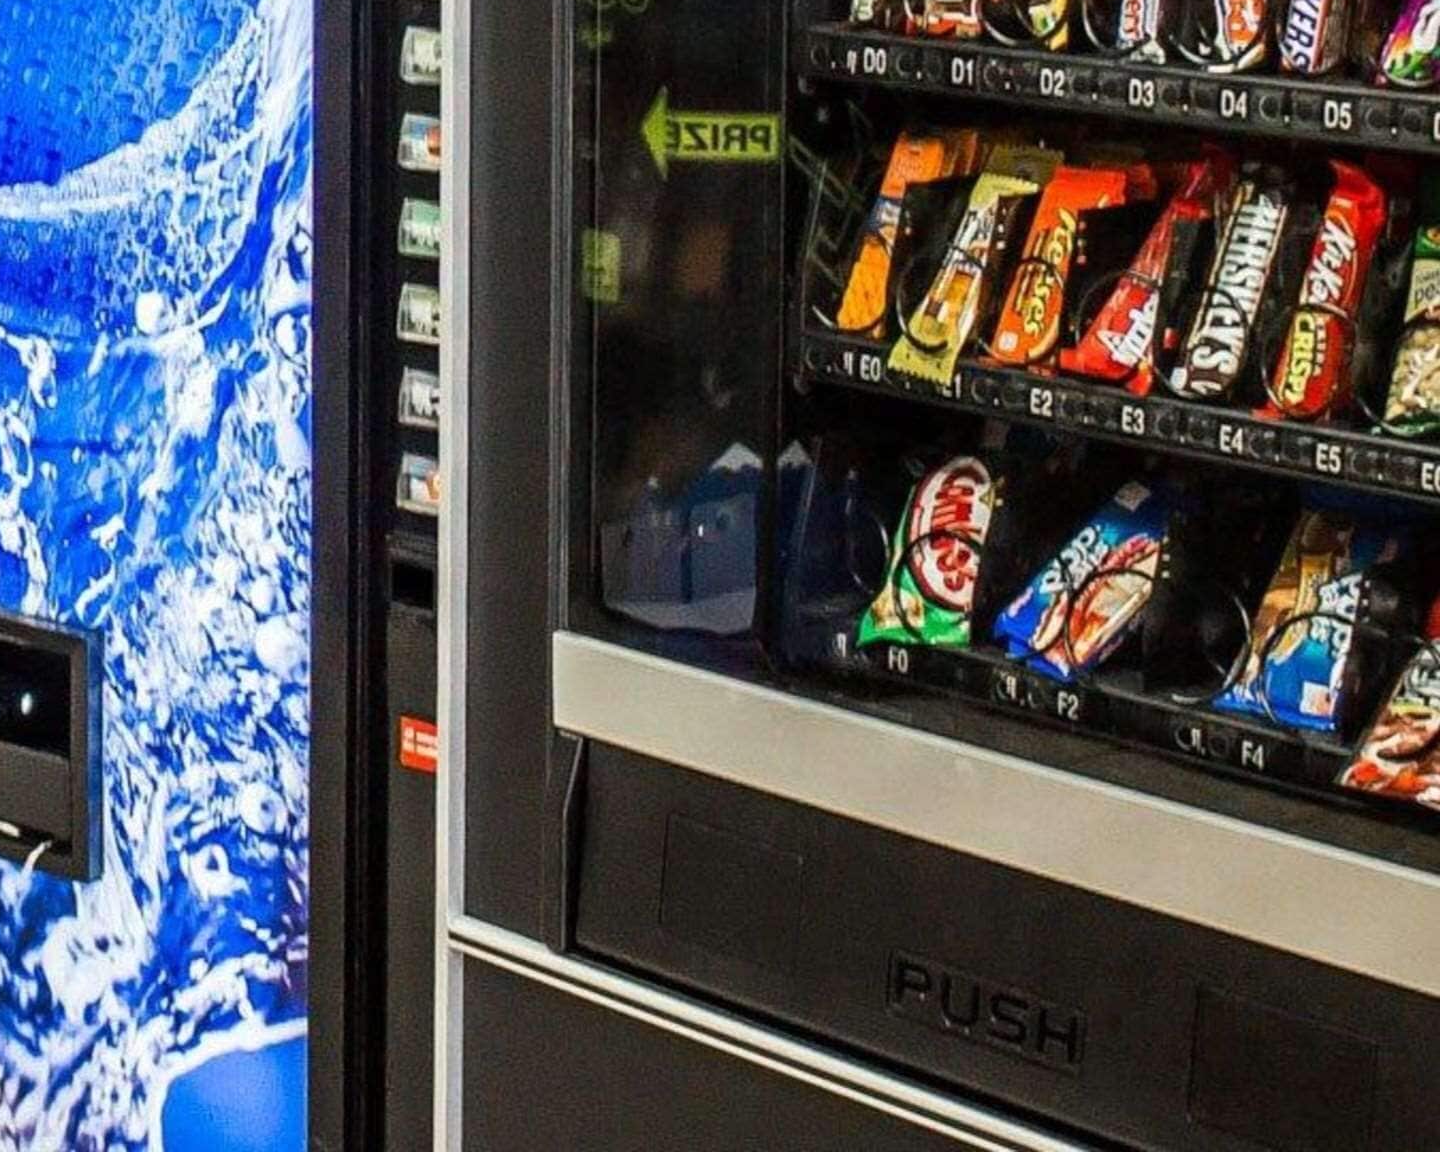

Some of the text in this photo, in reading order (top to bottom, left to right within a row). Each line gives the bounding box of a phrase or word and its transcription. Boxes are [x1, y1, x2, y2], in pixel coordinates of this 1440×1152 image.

[863, 46, 887, 74] D0
[951, 57, 975, 84] D1
[1040, 67, 1065, 96] D2
[1128, 79, 1155, 109] D3
[1220, 89, 1248, 119] D4
[1323, 101, 1353, 130] D5
[860, 354, 881, 382] E0
[1030, 388, 1053, 416] E2
[1121, 406, 1145, 434] E3
[1219, 425, 1243, 454] E4
[1316, 444, 1341, 473] E5
[888, 647, 908, 673] F0
[1058, 692, 1079, 720] F2
[1241, 741, 1264, 770] F4
[894, 958, 1078, 1065] PUSH
